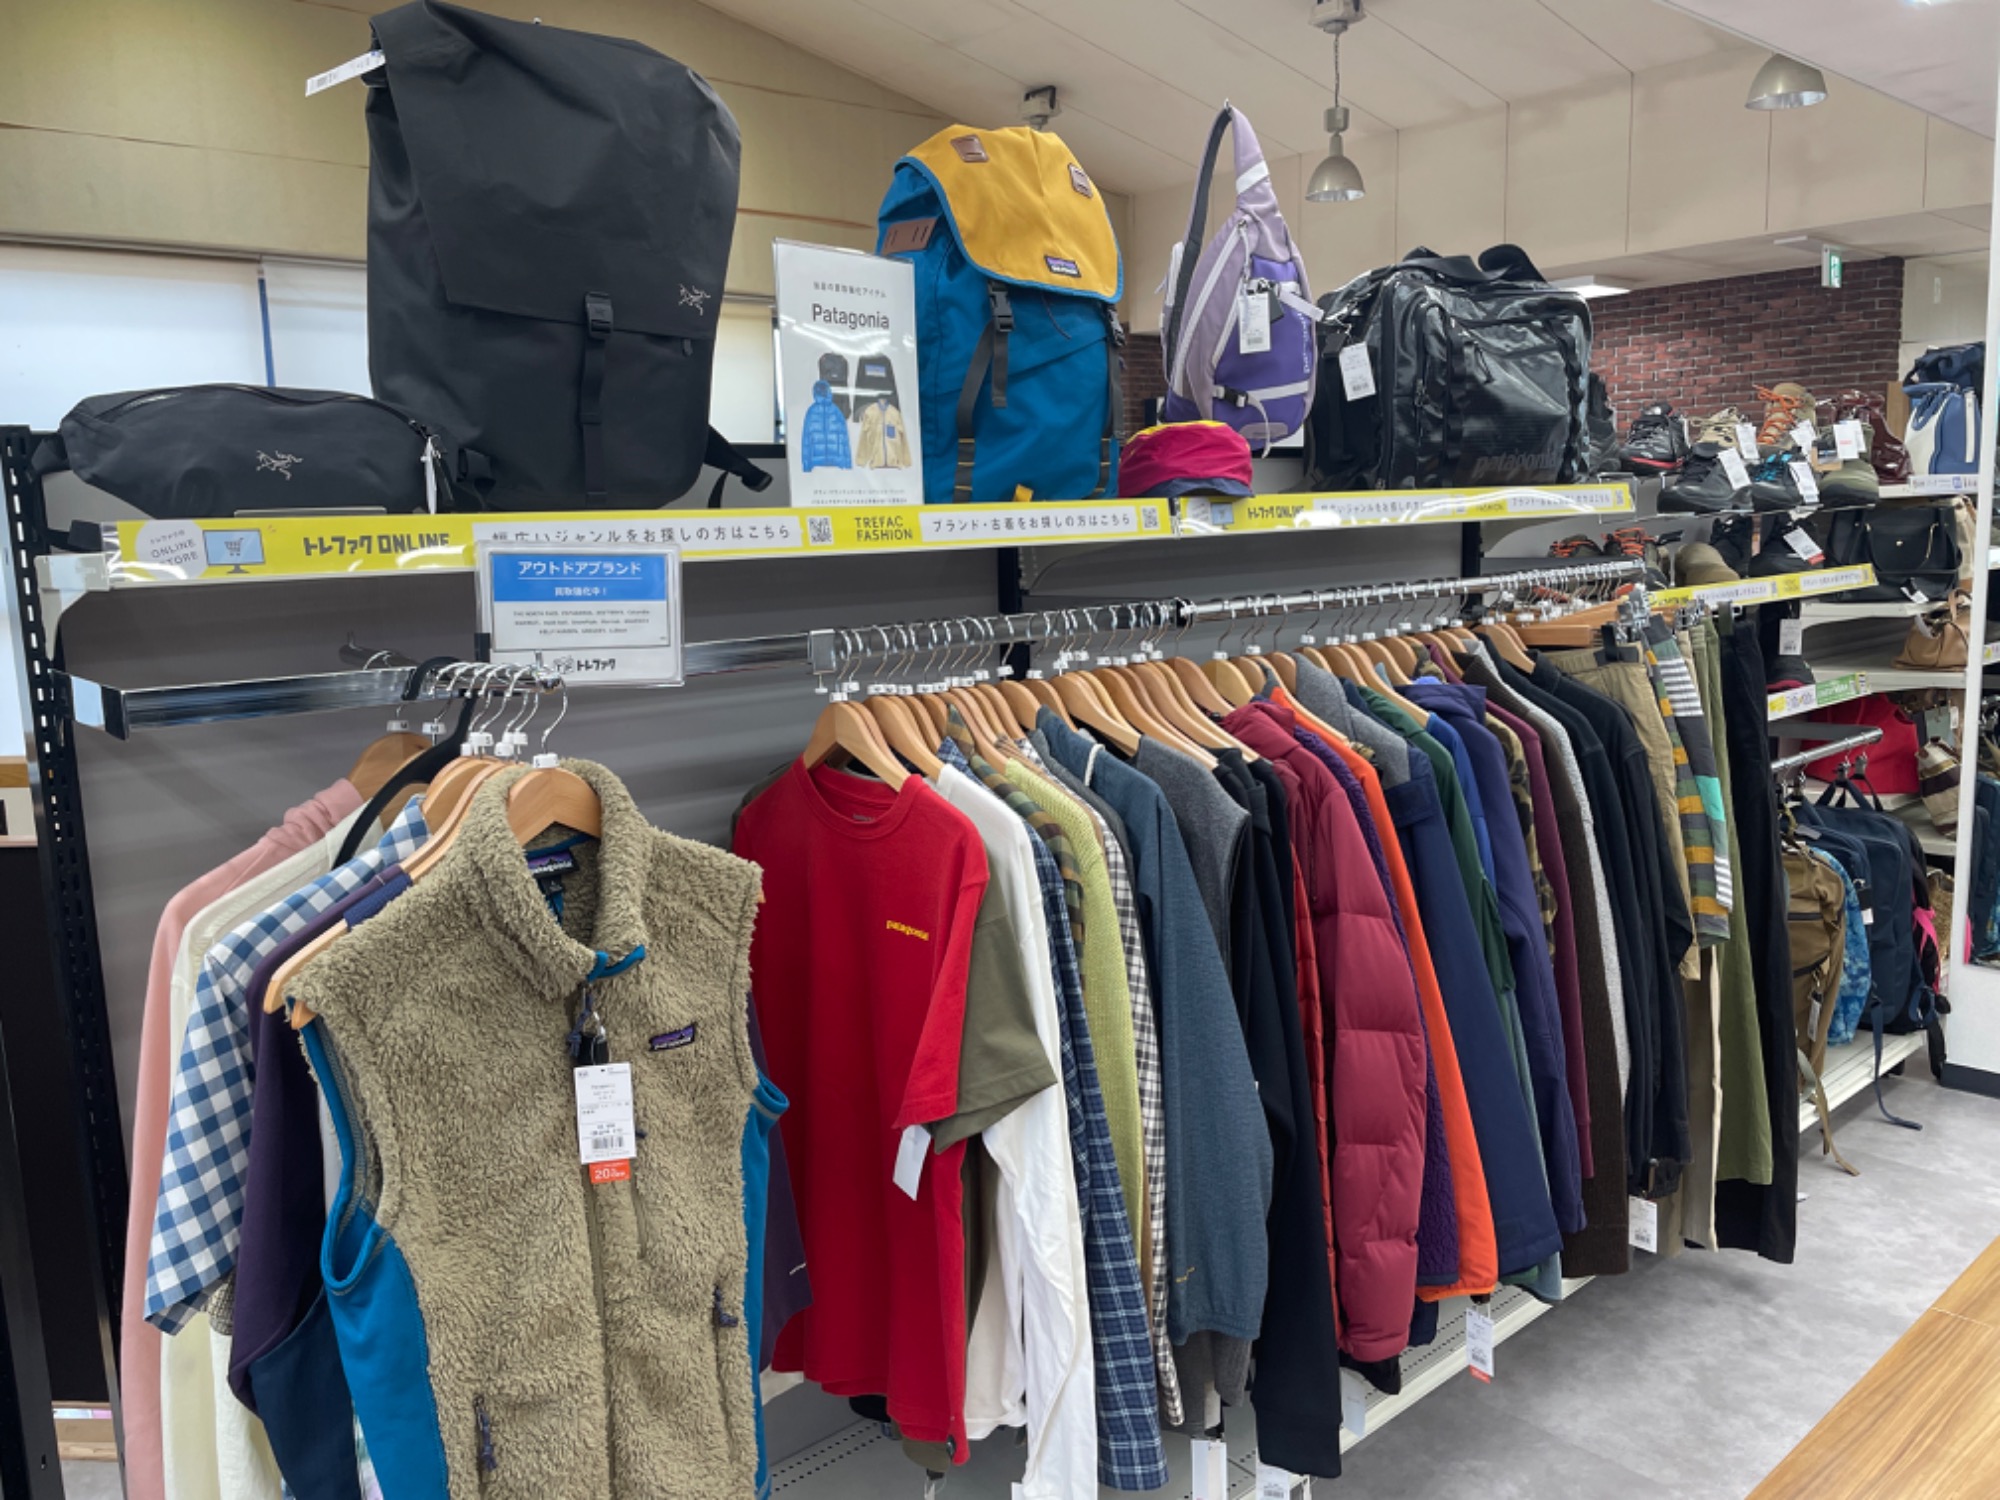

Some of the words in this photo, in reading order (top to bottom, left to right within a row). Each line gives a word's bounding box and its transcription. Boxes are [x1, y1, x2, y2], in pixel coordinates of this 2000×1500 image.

[812, 302, 890, 330] Patagonia
[855, 515, 904, 528] TREFAC
[856, 529, 913, 541] FASHION
[151, 538, 196, 558] ONLINE
[158, 550, 199, 566] TORE
[518, 560, 643, 576] アウトドアブランド
